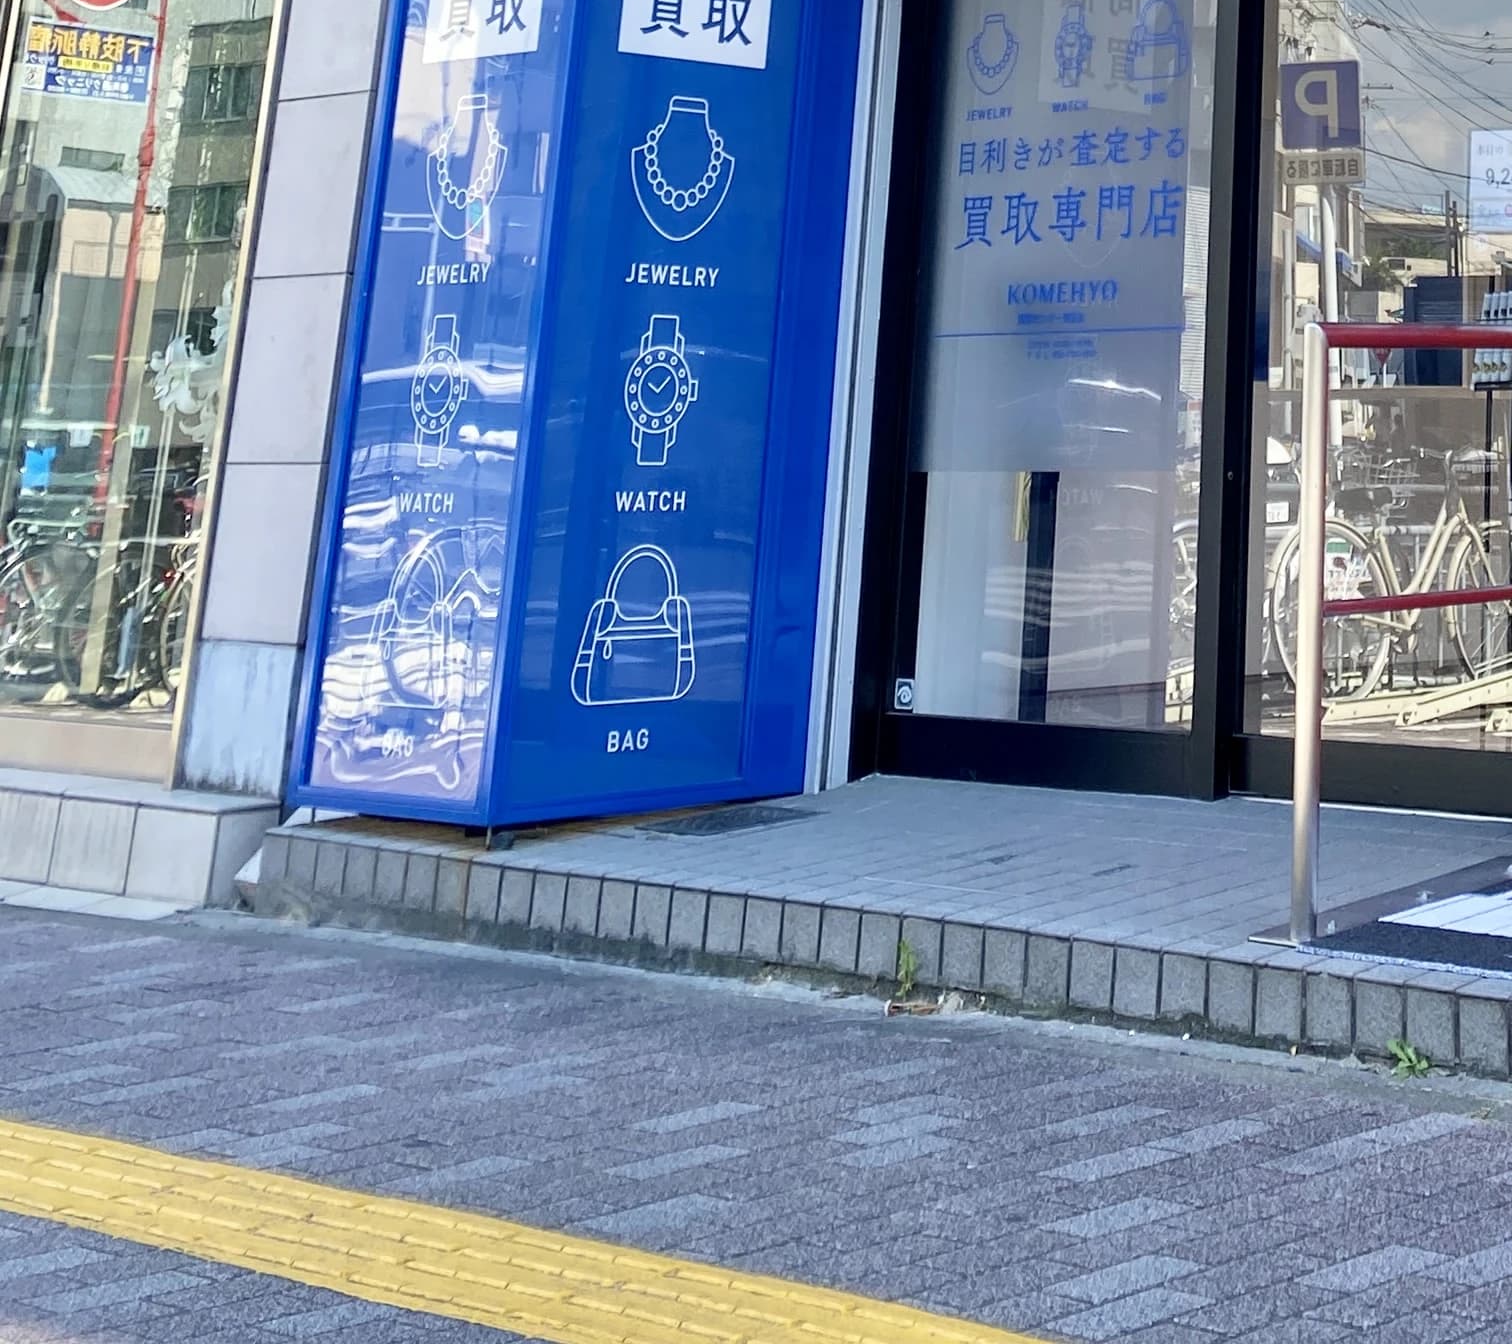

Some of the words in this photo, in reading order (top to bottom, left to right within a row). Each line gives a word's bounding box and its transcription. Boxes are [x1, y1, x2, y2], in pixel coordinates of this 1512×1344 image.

[965, 105, 1013, 122] JEWELRY
[953, 178, 1184, 252] 買取専門店
[416, 262, 491, 286] JEWELRY
[625, 263, 720, 288] JEWELRY
[1007, 279, 1119, 305] KOMEHYO
[399, 491, 455, 515] WATCH
[615, 490, 687, 513] WATCH
[606, 729, 650, 754] BAG
